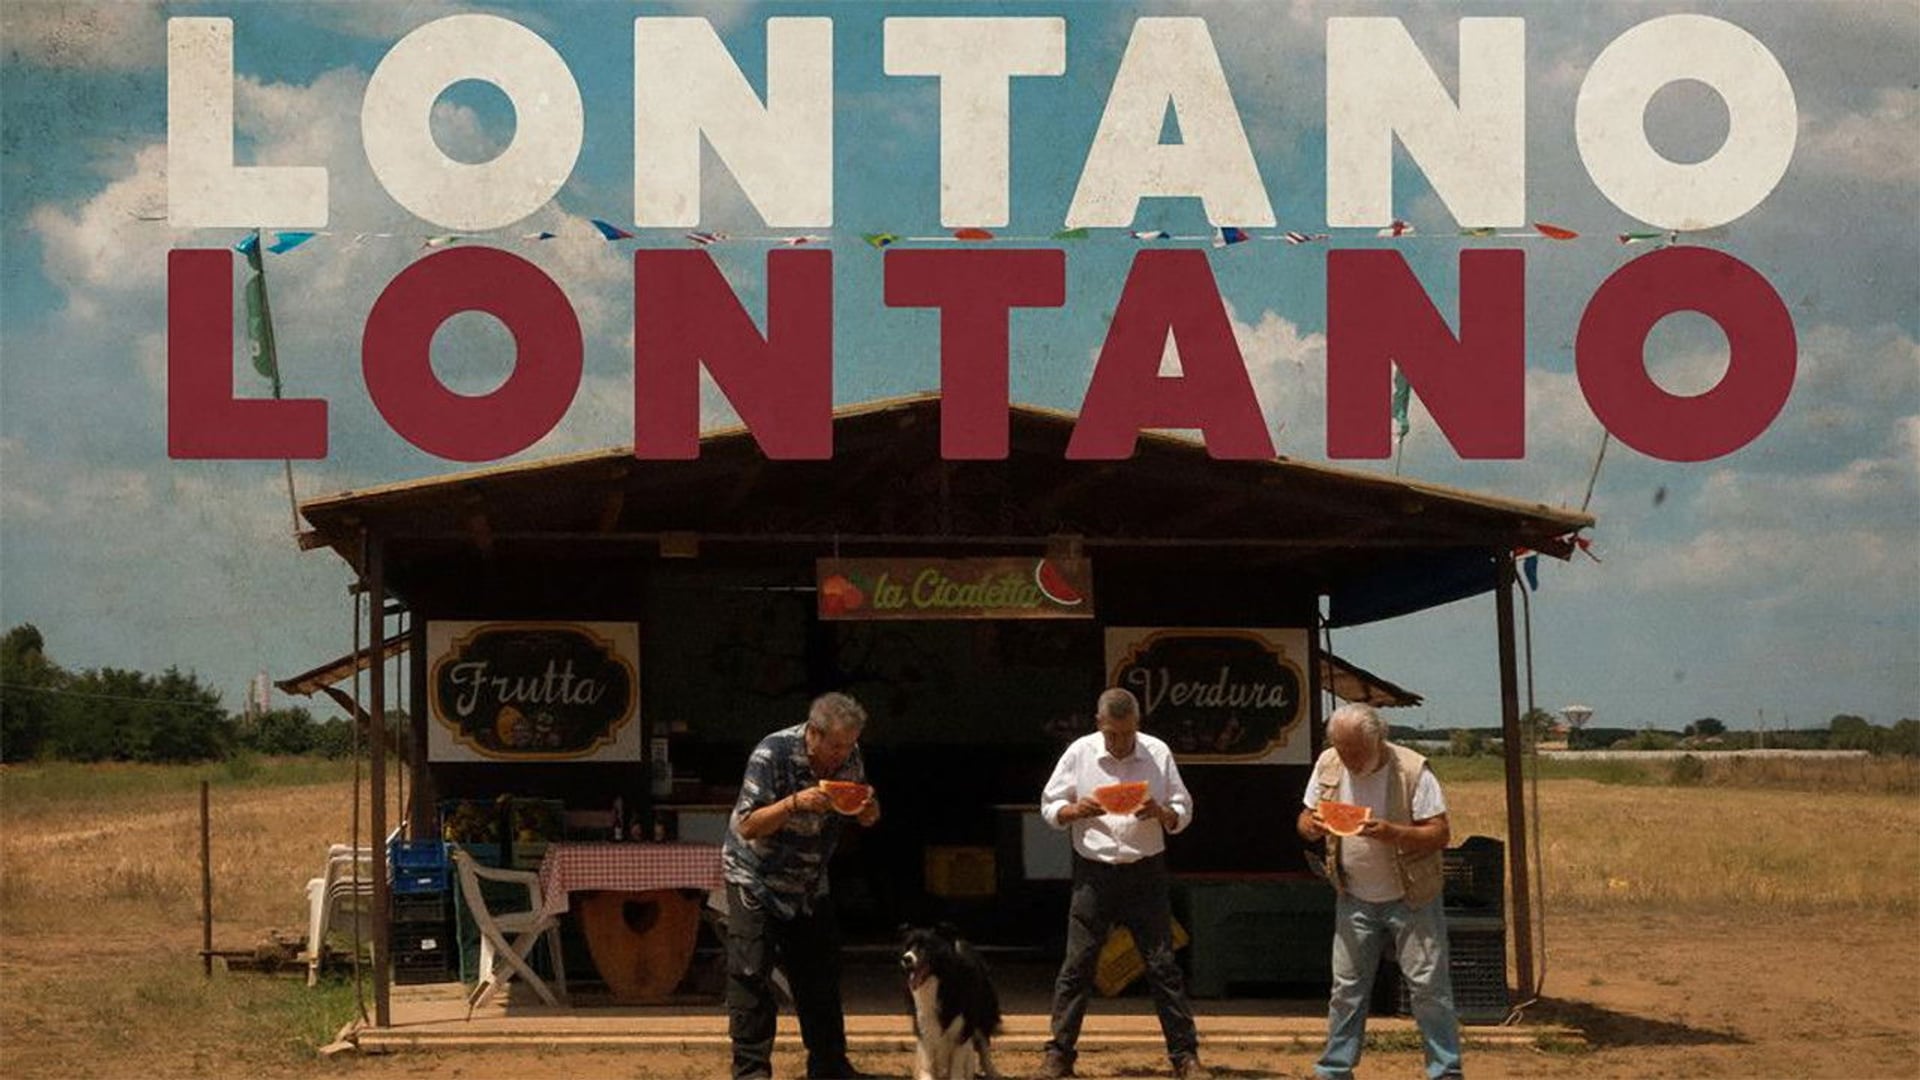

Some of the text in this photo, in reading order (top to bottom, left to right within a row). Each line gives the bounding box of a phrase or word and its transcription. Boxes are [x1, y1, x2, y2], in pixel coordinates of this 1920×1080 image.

[873, 571, 907, 609] la
[449, 657, 608, 717] Frutta
[1127, 664, 1290, 716] Verdura
